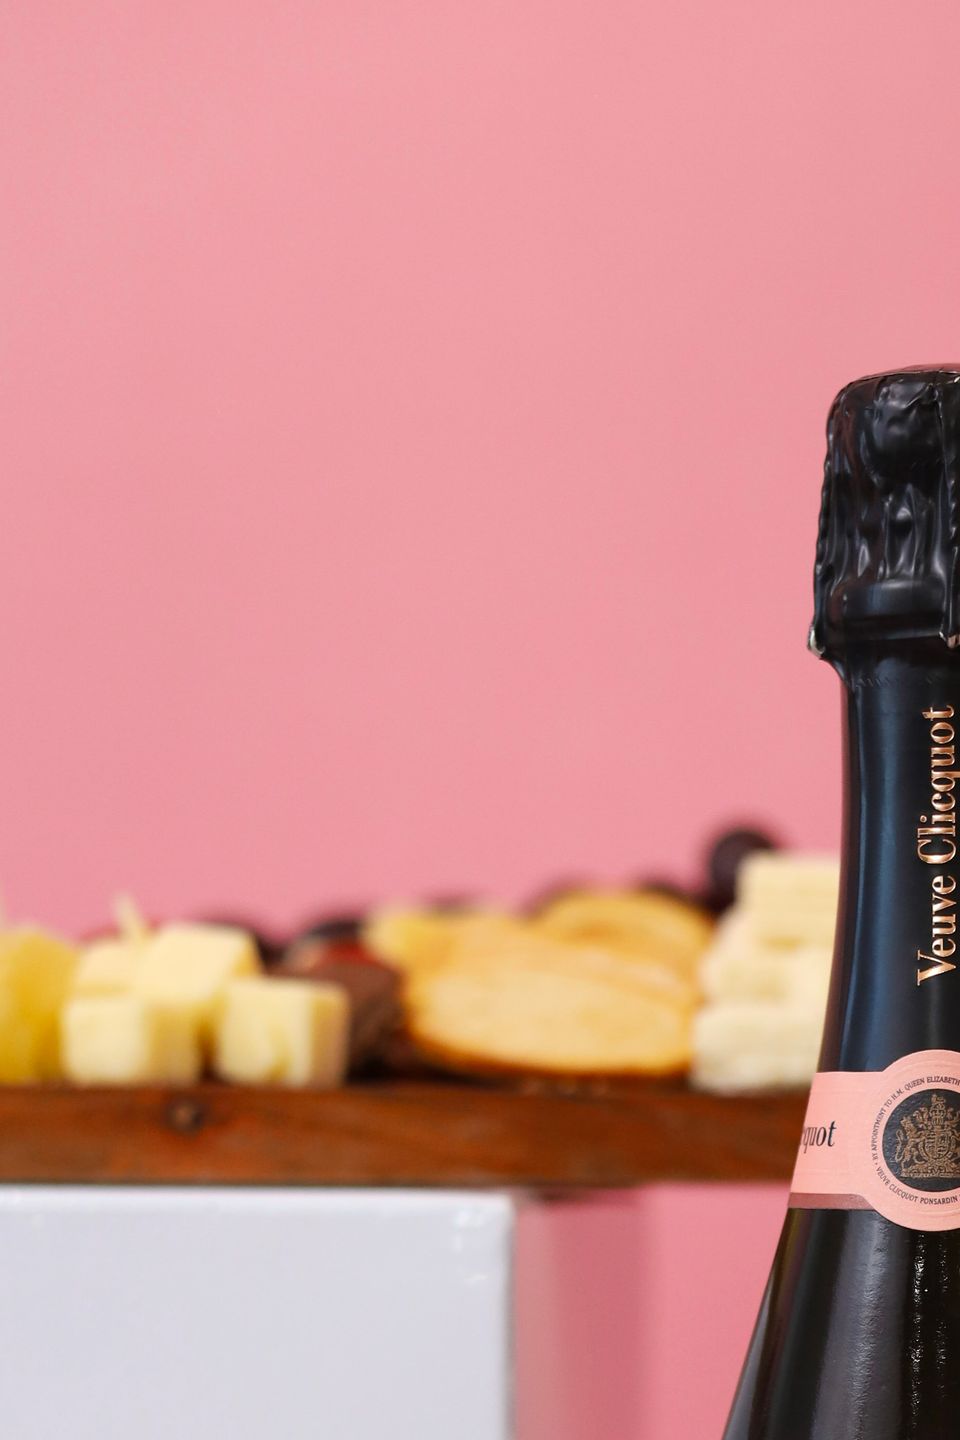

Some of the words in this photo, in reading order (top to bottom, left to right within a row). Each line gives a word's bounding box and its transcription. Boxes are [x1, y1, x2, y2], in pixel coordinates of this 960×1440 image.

[916, 875, 957, 986] Veuve
[871, 1107, 887, 1151] APPOINTMENT
[884, 1098, 893, 1108] TO
[904, 1077, 925, 1091] QUEEN
[926, 1075, 960, 1086] ELIZABETH
[876, 1166, 891, 1186] VEUVE
[888, 1183, 918, 1202] CLICQUOT
[919, 1194, 959, 1205] PONSARDIN
